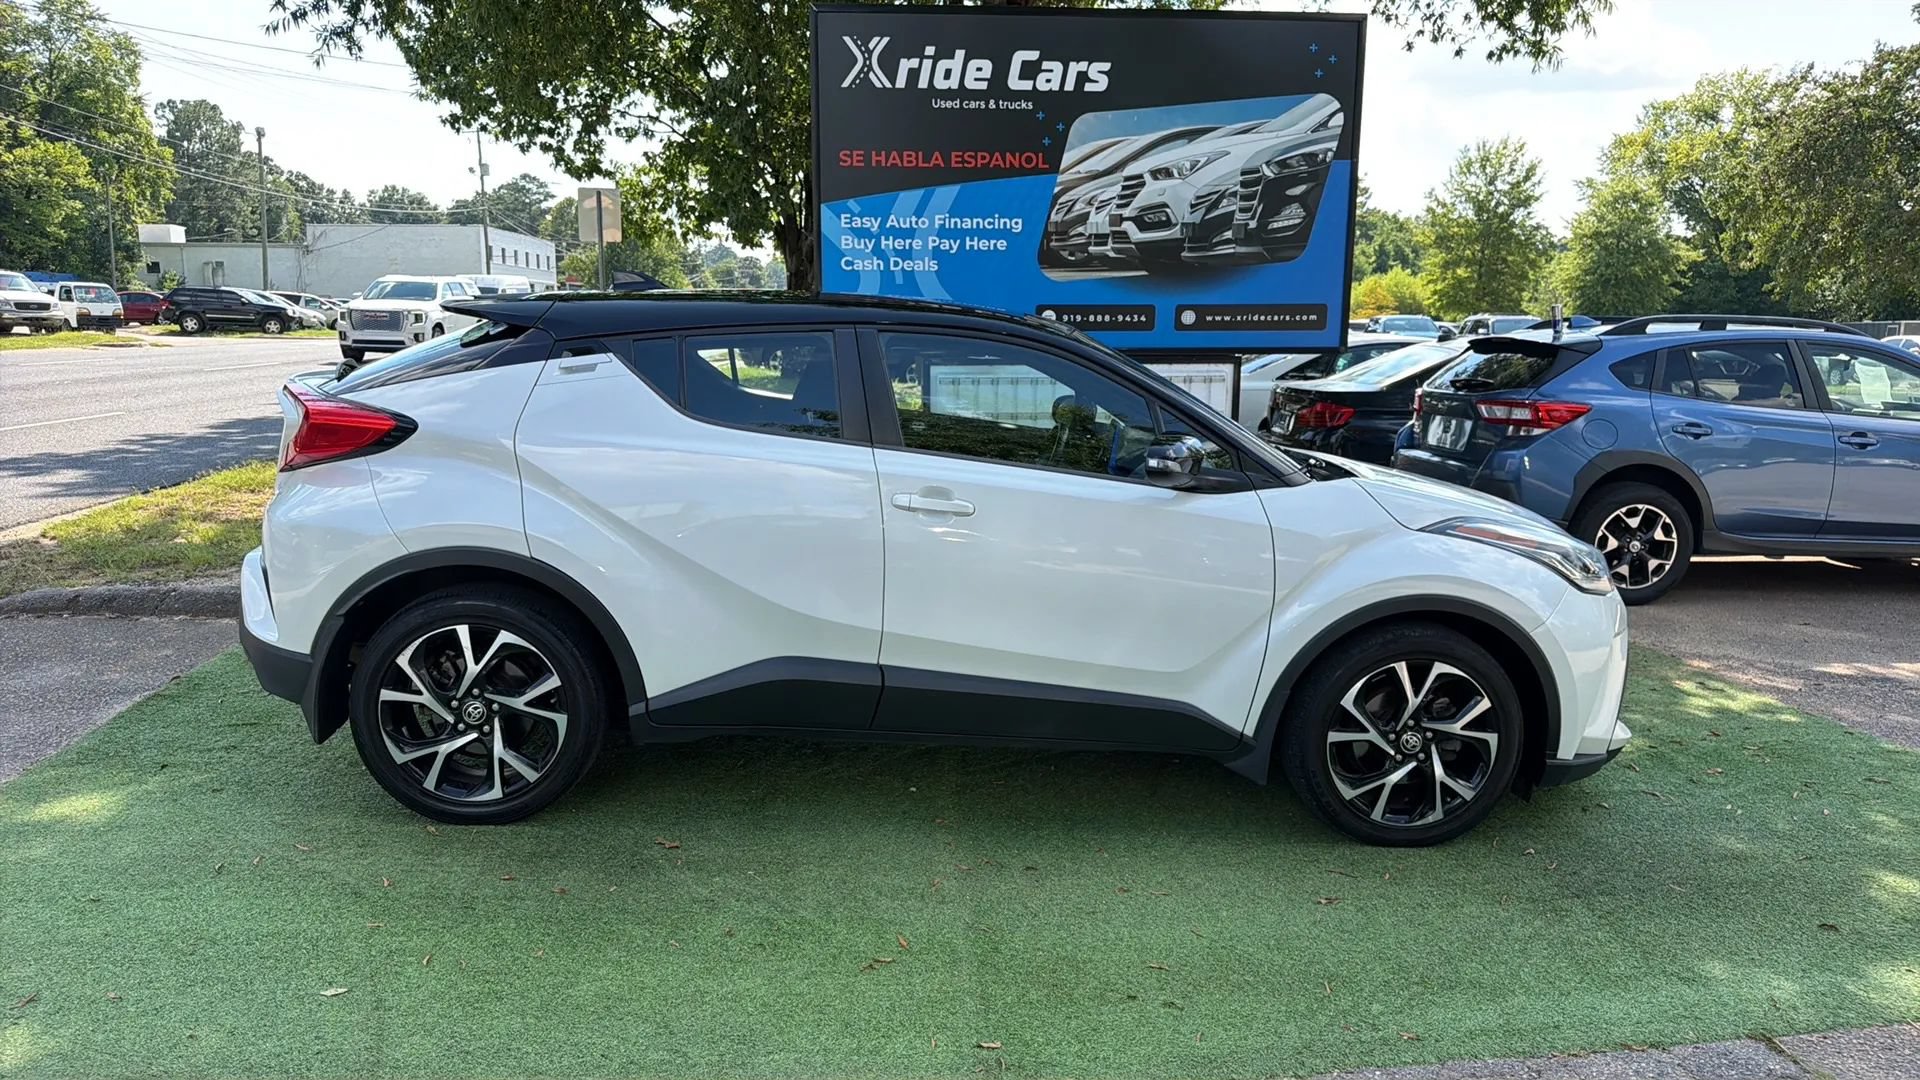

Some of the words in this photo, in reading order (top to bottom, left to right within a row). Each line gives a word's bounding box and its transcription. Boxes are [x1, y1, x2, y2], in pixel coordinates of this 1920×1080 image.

[1007, 50, 1111, 92] Cars
[932, 98, 960, 109] Used
[962, 100, 985, 110] cars
[988, 99, 996, 109] &
[999, 99, 1033, 110] trucks
[839, 151, 864, 167] SE
[871, 151, 944, 168] HABLA
[951, 152, 1049, 169] ESPANOL
[840, 214, 881, 230] Easy
[886, 214, 929, 229] Auto
[934, 214, 1023, 233] Financing
[841, 235, 876, 251] Buy
[881, 236, 923, 250] Here
[928, 237, 960, 254] Pay
[966, 237, 1008, 251] Here
[840, 257, 884, 271] Cash
[890, 258, 938, 272] Deals
[1062, 313, 1147, 323] 919-888-9434
[1205, 313, 1318, 322] www.xridecars.com
